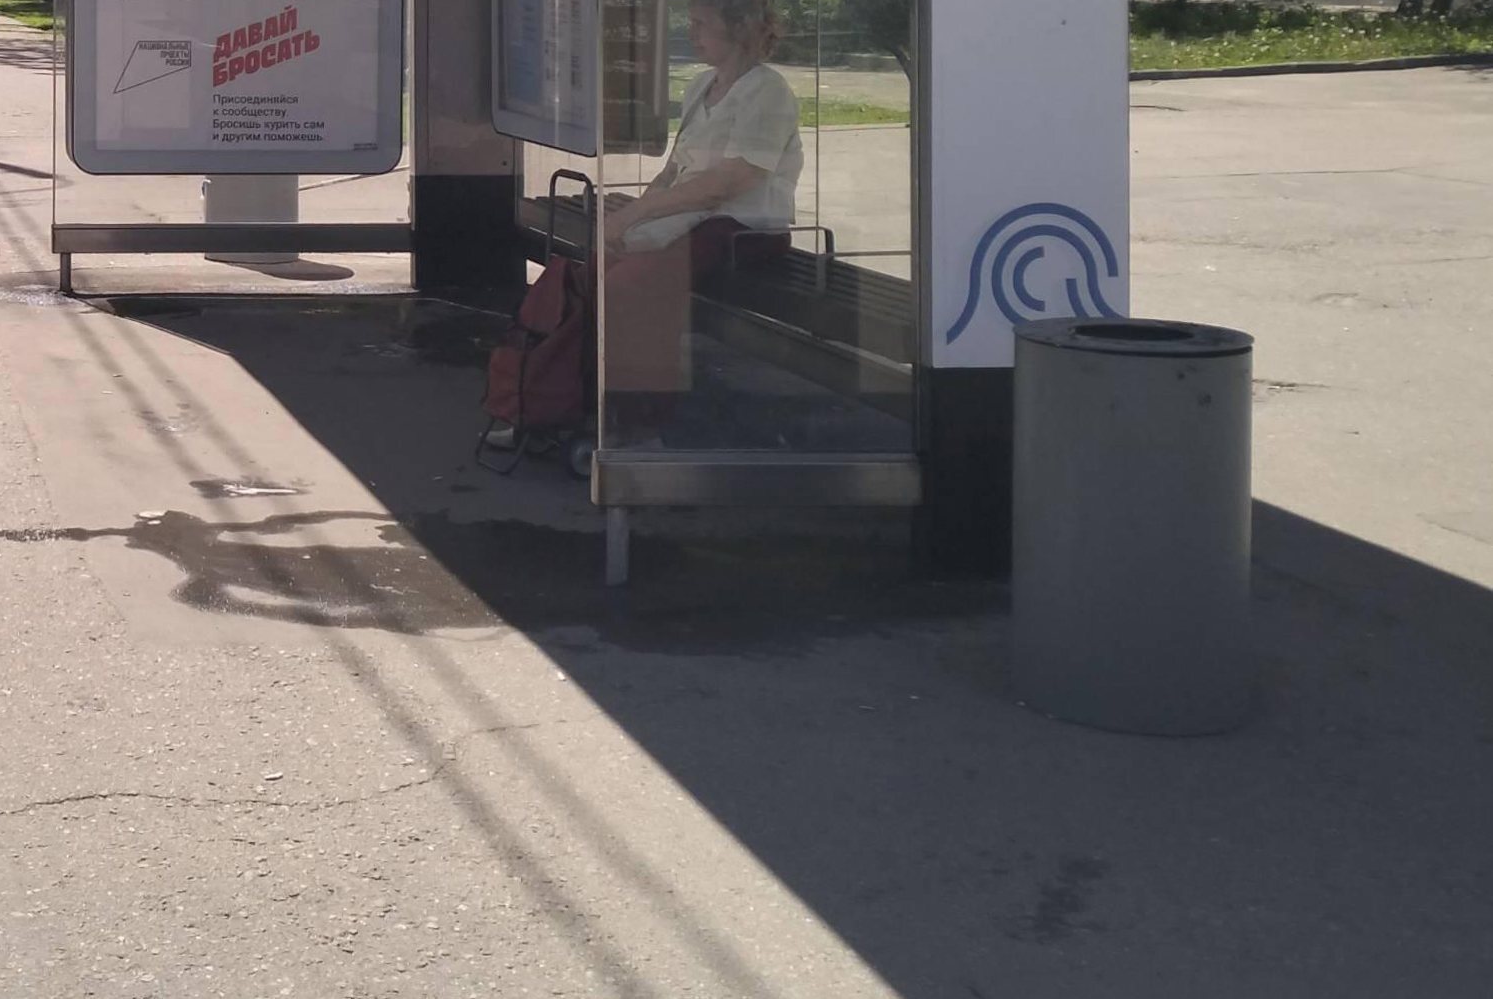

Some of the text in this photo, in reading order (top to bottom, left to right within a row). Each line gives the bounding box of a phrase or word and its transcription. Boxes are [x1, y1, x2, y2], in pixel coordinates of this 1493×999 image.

[213, 4, 298, 63] ДАВАЙ
[212, 29, 321, 88] БРОСАТЬ
[213, 94, 299, 106] Присоединяйся
[212, 119, 325, 131] Бросишь курить сам
[221, 133, 261, 144] другим
